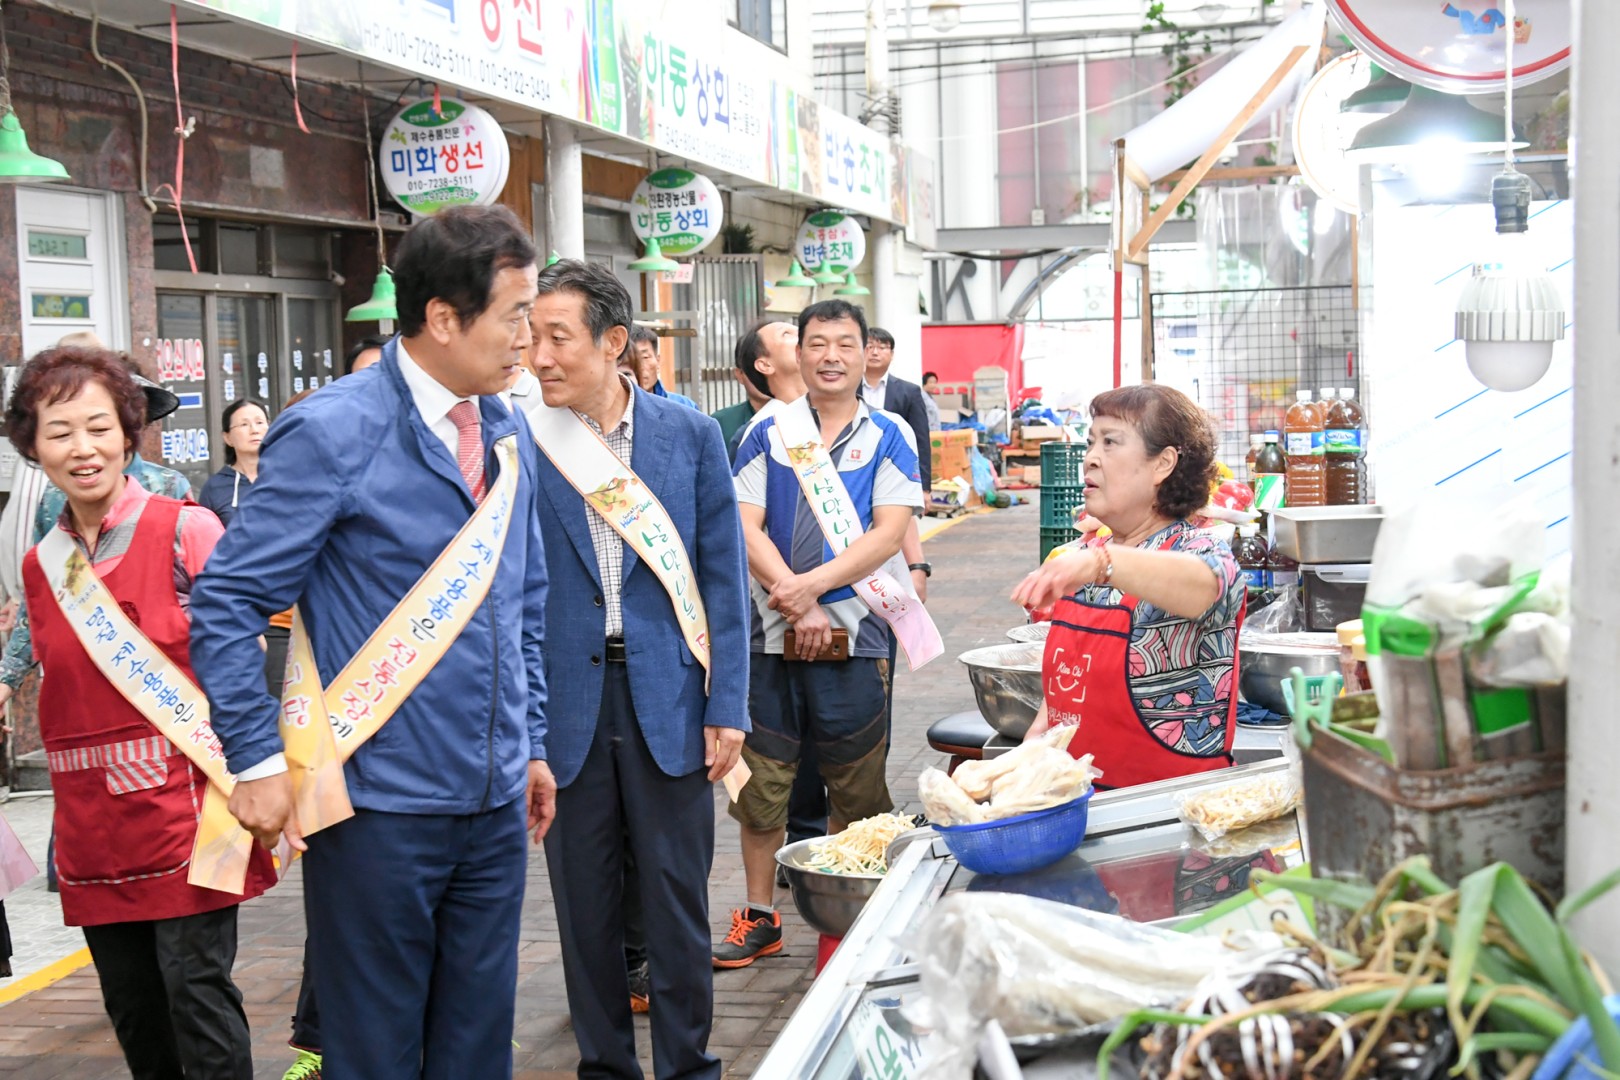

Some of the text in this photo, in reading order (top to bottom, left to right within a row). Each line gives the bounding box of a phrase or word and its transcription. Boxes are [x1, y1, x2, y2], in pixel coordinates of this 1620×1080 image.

[479, 60, 551, 101] 010-9122-3434
[644, 30, 730, 133] 하동상회
[410, 127, 460, 143] 제수용품전문
[391, 140, 484, 177] 미화생선
[824, 127, 887, 203] 반송초재
[408, 175, 473, 191] 010-7238-5111
[408, 188, 475, 204] 010-9122-3434
[637, 209, 708, 233] 하동상회
[803, 241, 853, 263] 반송초재
[411, 537, 495, 640] 제수용품은
[641, 522, 697, 621] 살맛나는
[85, 606, 117, 643] 명절
[111, 641, 194, 723] 제수용품은
